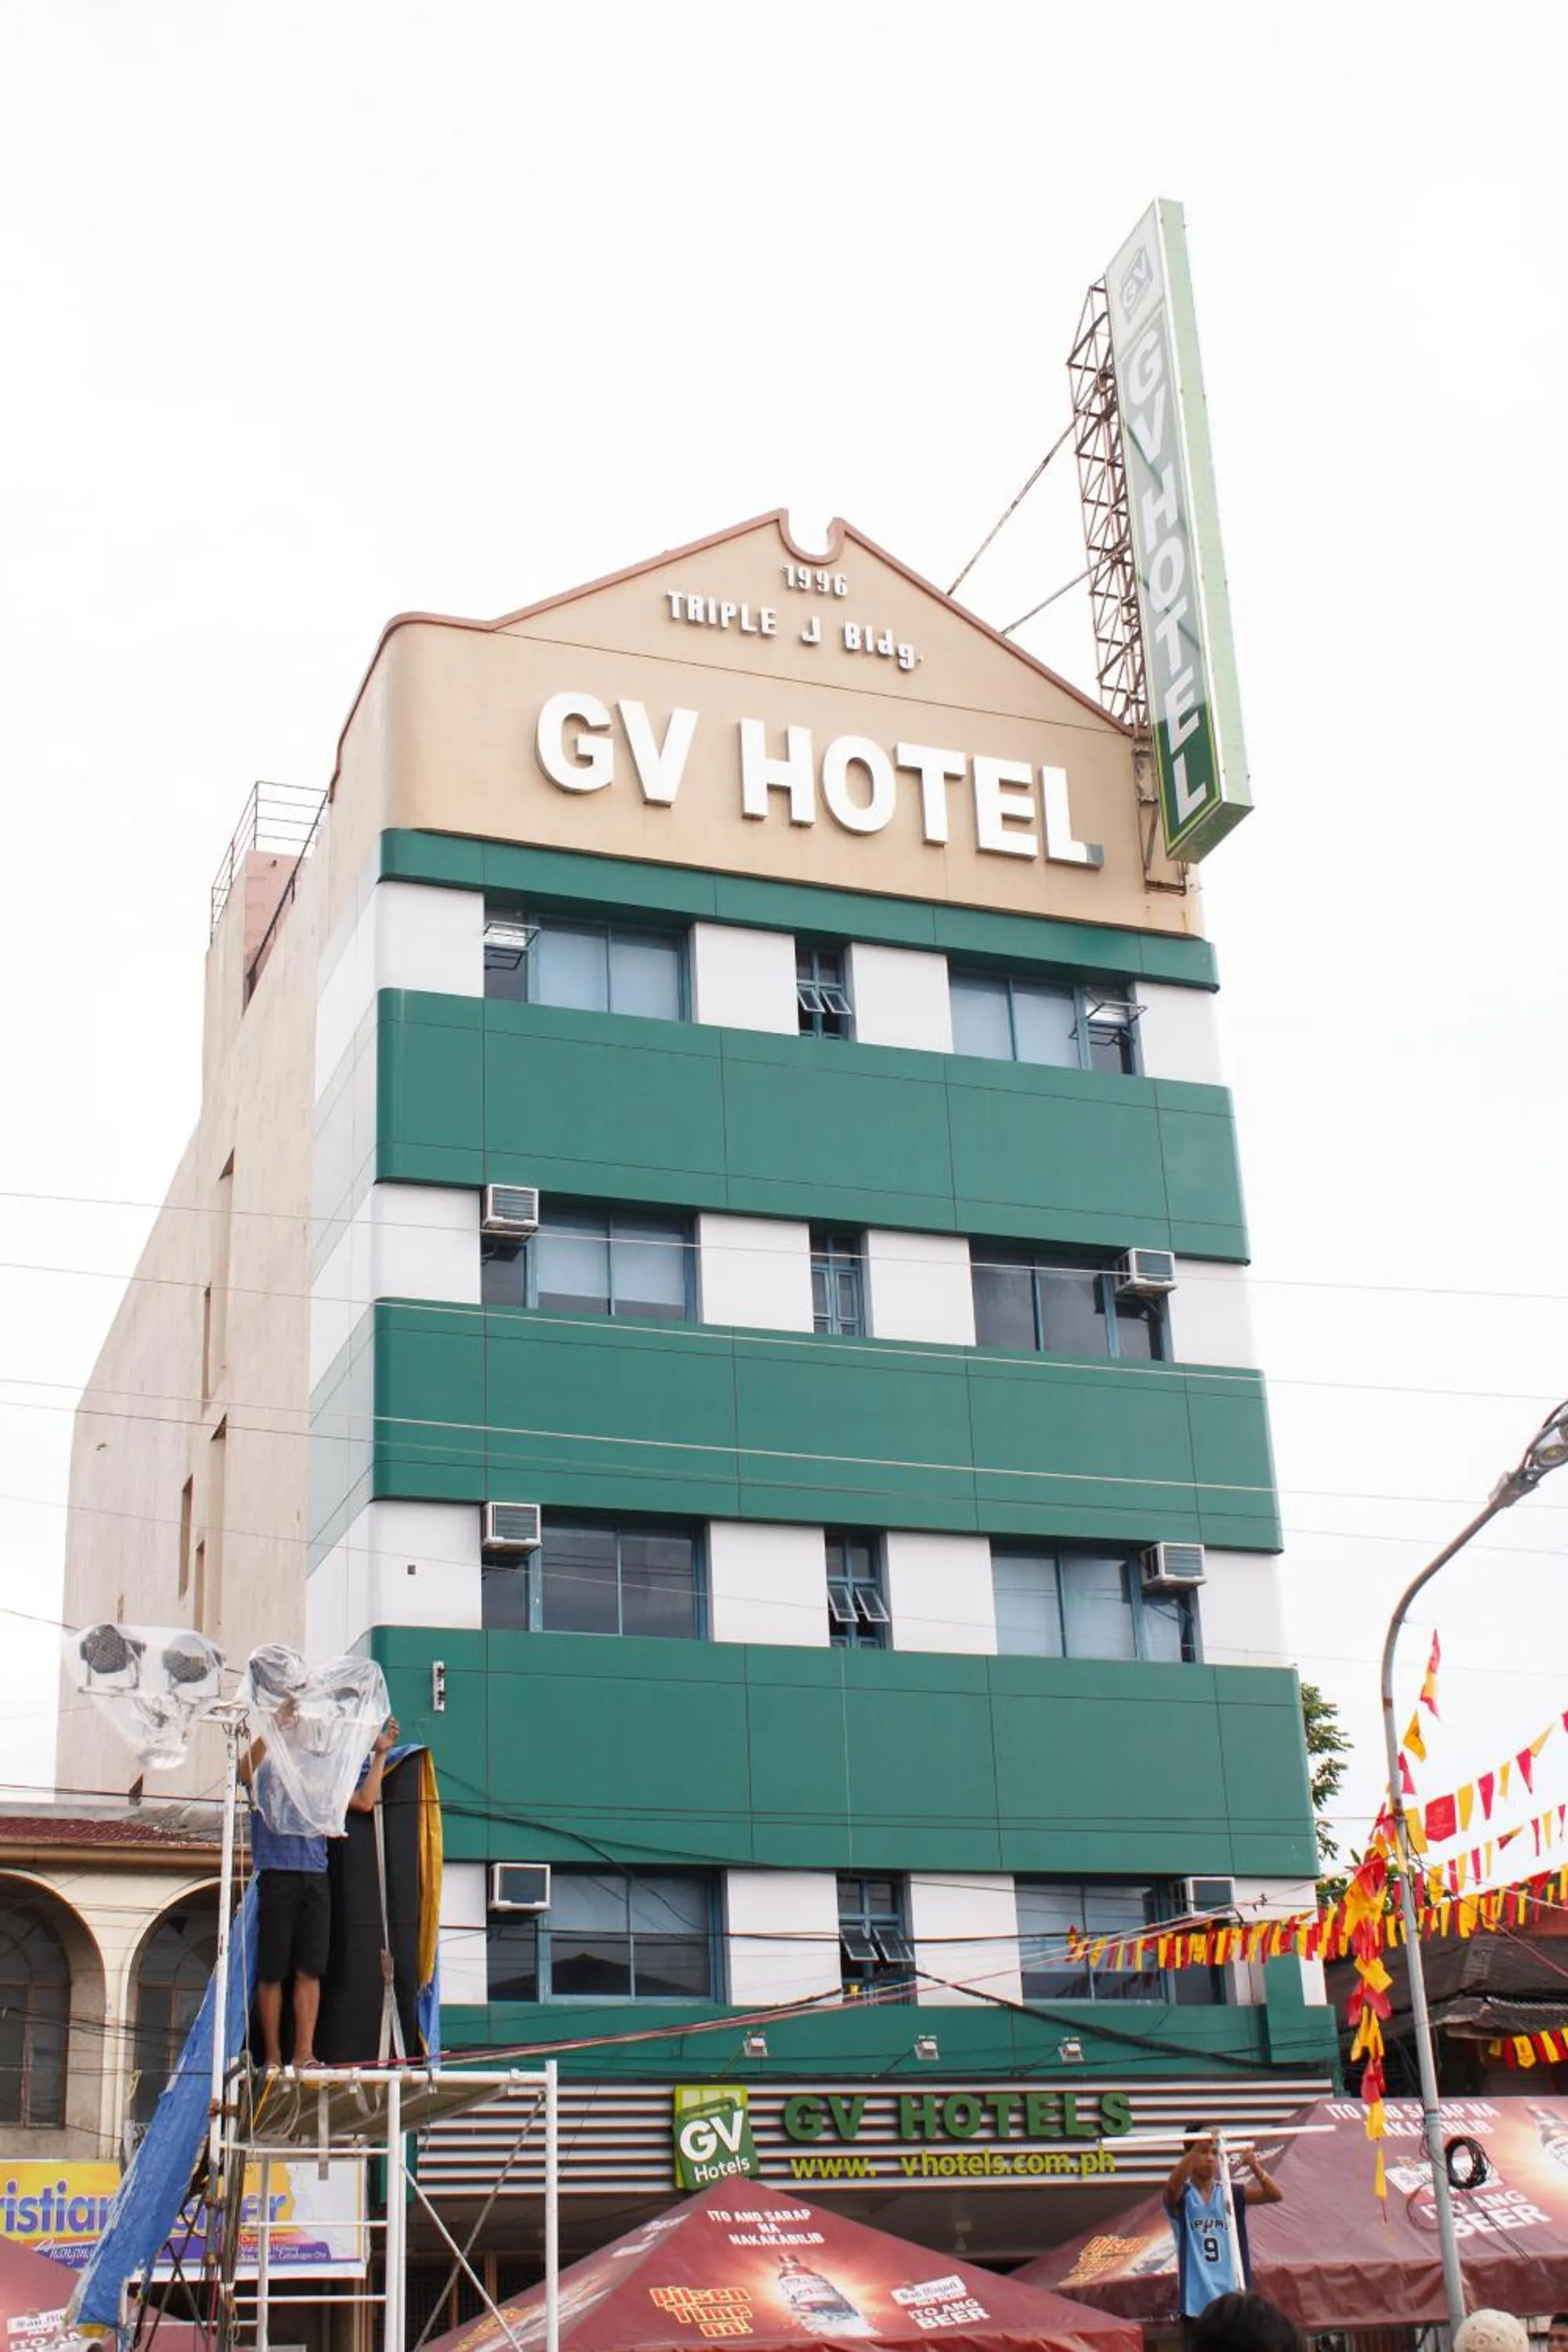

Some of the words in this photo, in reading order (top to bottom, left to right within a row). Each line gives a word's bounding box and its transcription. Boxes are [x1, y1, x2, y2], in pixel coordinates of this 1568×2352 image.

[782, 563, 850, 597] 1996
[666, 589, 779, 637] TRIPLE
[801, 615, 822, 644] J
[1142, 461, 1207, 825] HOTEL
[536, 692, 698, 808] GV
[739, 717, 1103, 870] HOTEL
[783, 2095, 867, 2142] GV
[898, 2092, 1133, 2139] HOTELS
[1325, 2104, 1360, 2119] ITO
[680, 2108, 744, 2162] GV
[695, 2155, 751, 2183] Hotels
[0, 2180, 116, 2234] istia
[1472, 2190, 1529, 2209] ANG
[707, 2210, 732, 2222] ITO
[765, 2209, 811, 2222] SARAP
[757, 2223, 781, 2234] NA
[1452, 2203, 1552, 2238] BEER
[728, 2232, 825, 2246] NAKAKABILIB
[1203, 2237, 1220, 2263] 9
[649, 2285, 753, 2307] Pilsen
[908, 2306, 938, 2321] ITO
[942, 2297, 980, 2313] ANG
[665, 2304, 753, 2324] Time
[914, 2307, 992, 2330] BEER
